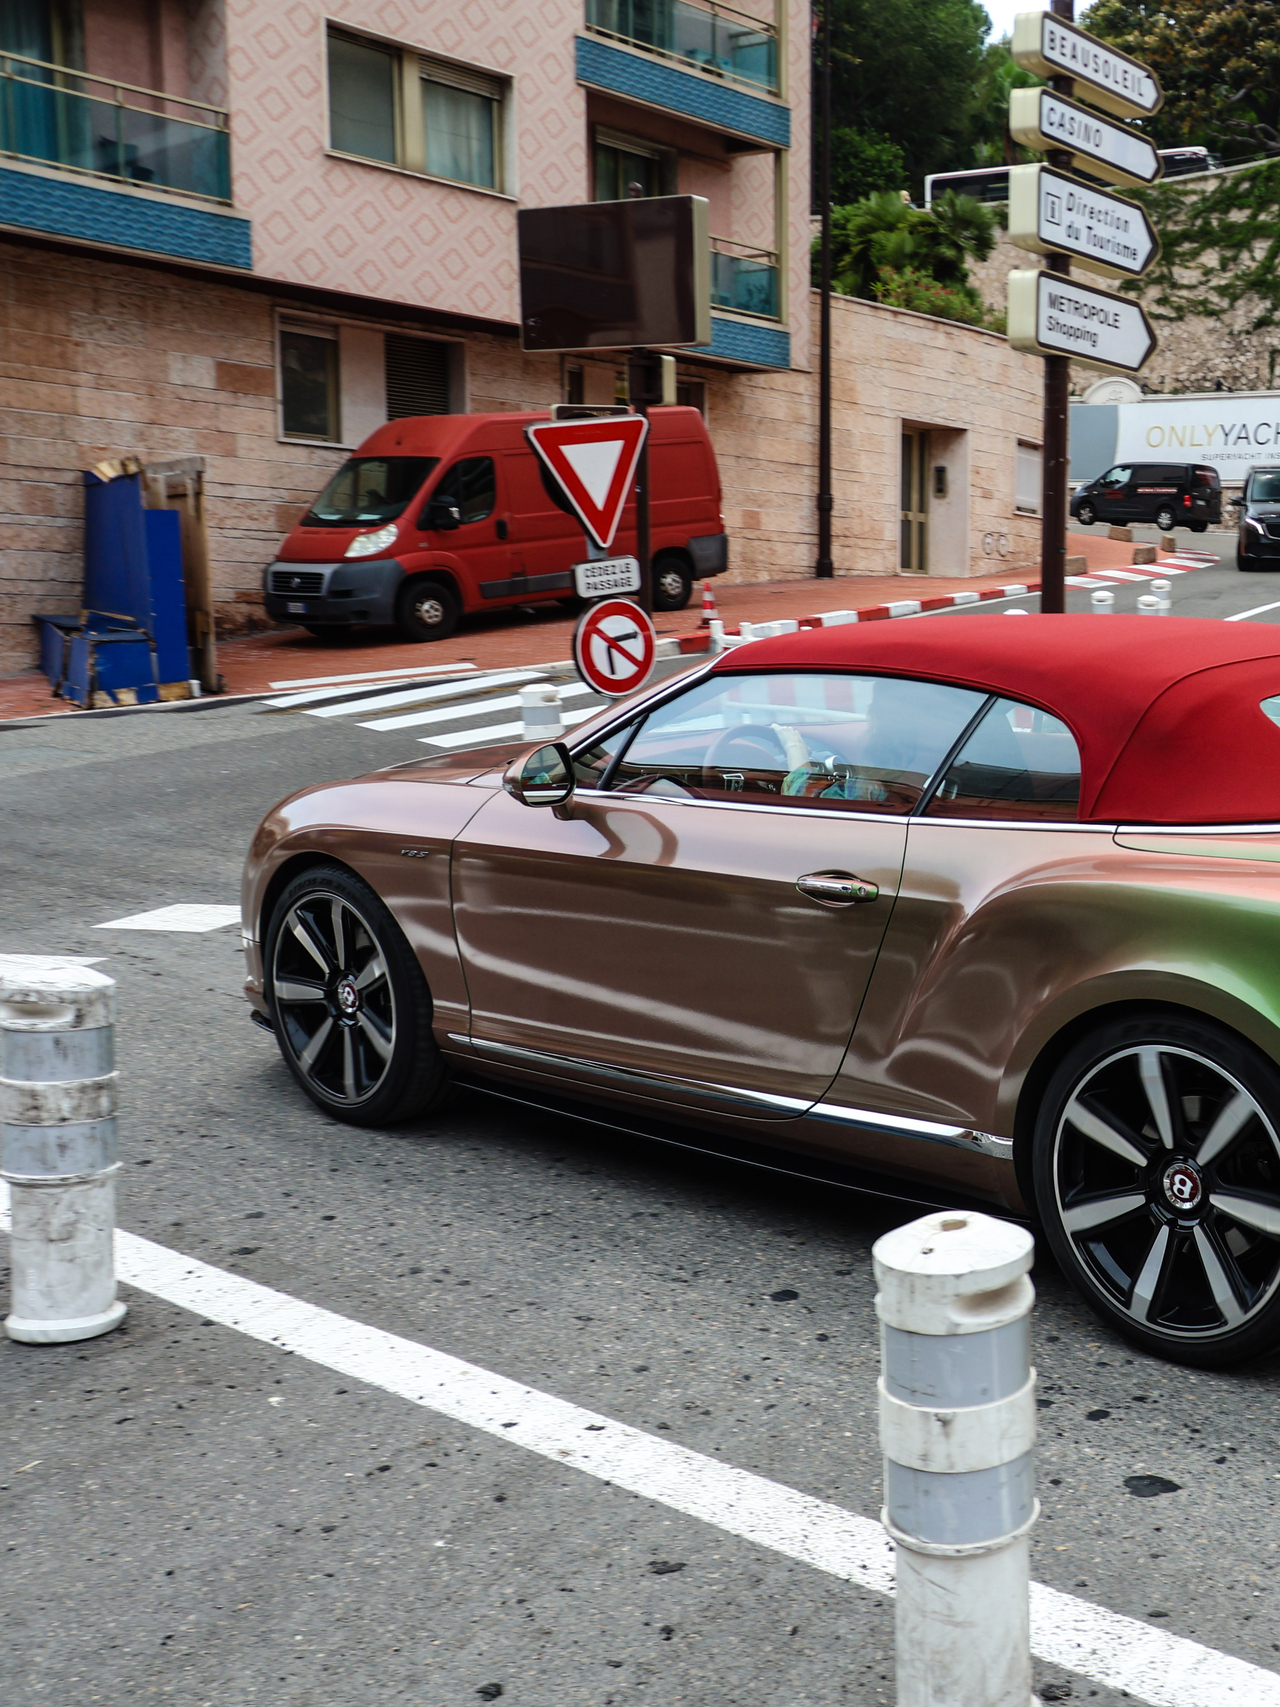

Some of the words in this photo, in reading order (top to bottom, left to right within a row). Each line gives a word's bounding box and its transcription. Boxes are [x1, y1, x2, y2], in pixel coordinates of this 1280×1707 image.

[1048, 29, 1145, 98] BEAUSOLEIL
[1046, 106, 1102, 148] CASINO
[1066, 192, 1130, 234] Direction
[1065, 220, 1081, 242] du
[1085, 226, 1139, 262] Tourisme
[1047, 291, 1121, 330] METROPOLE
[1046, 315, 1099, 348] Shopping
[585, 576, 633, 593] PASSAGE
[619, 562, 632, 574] LE
